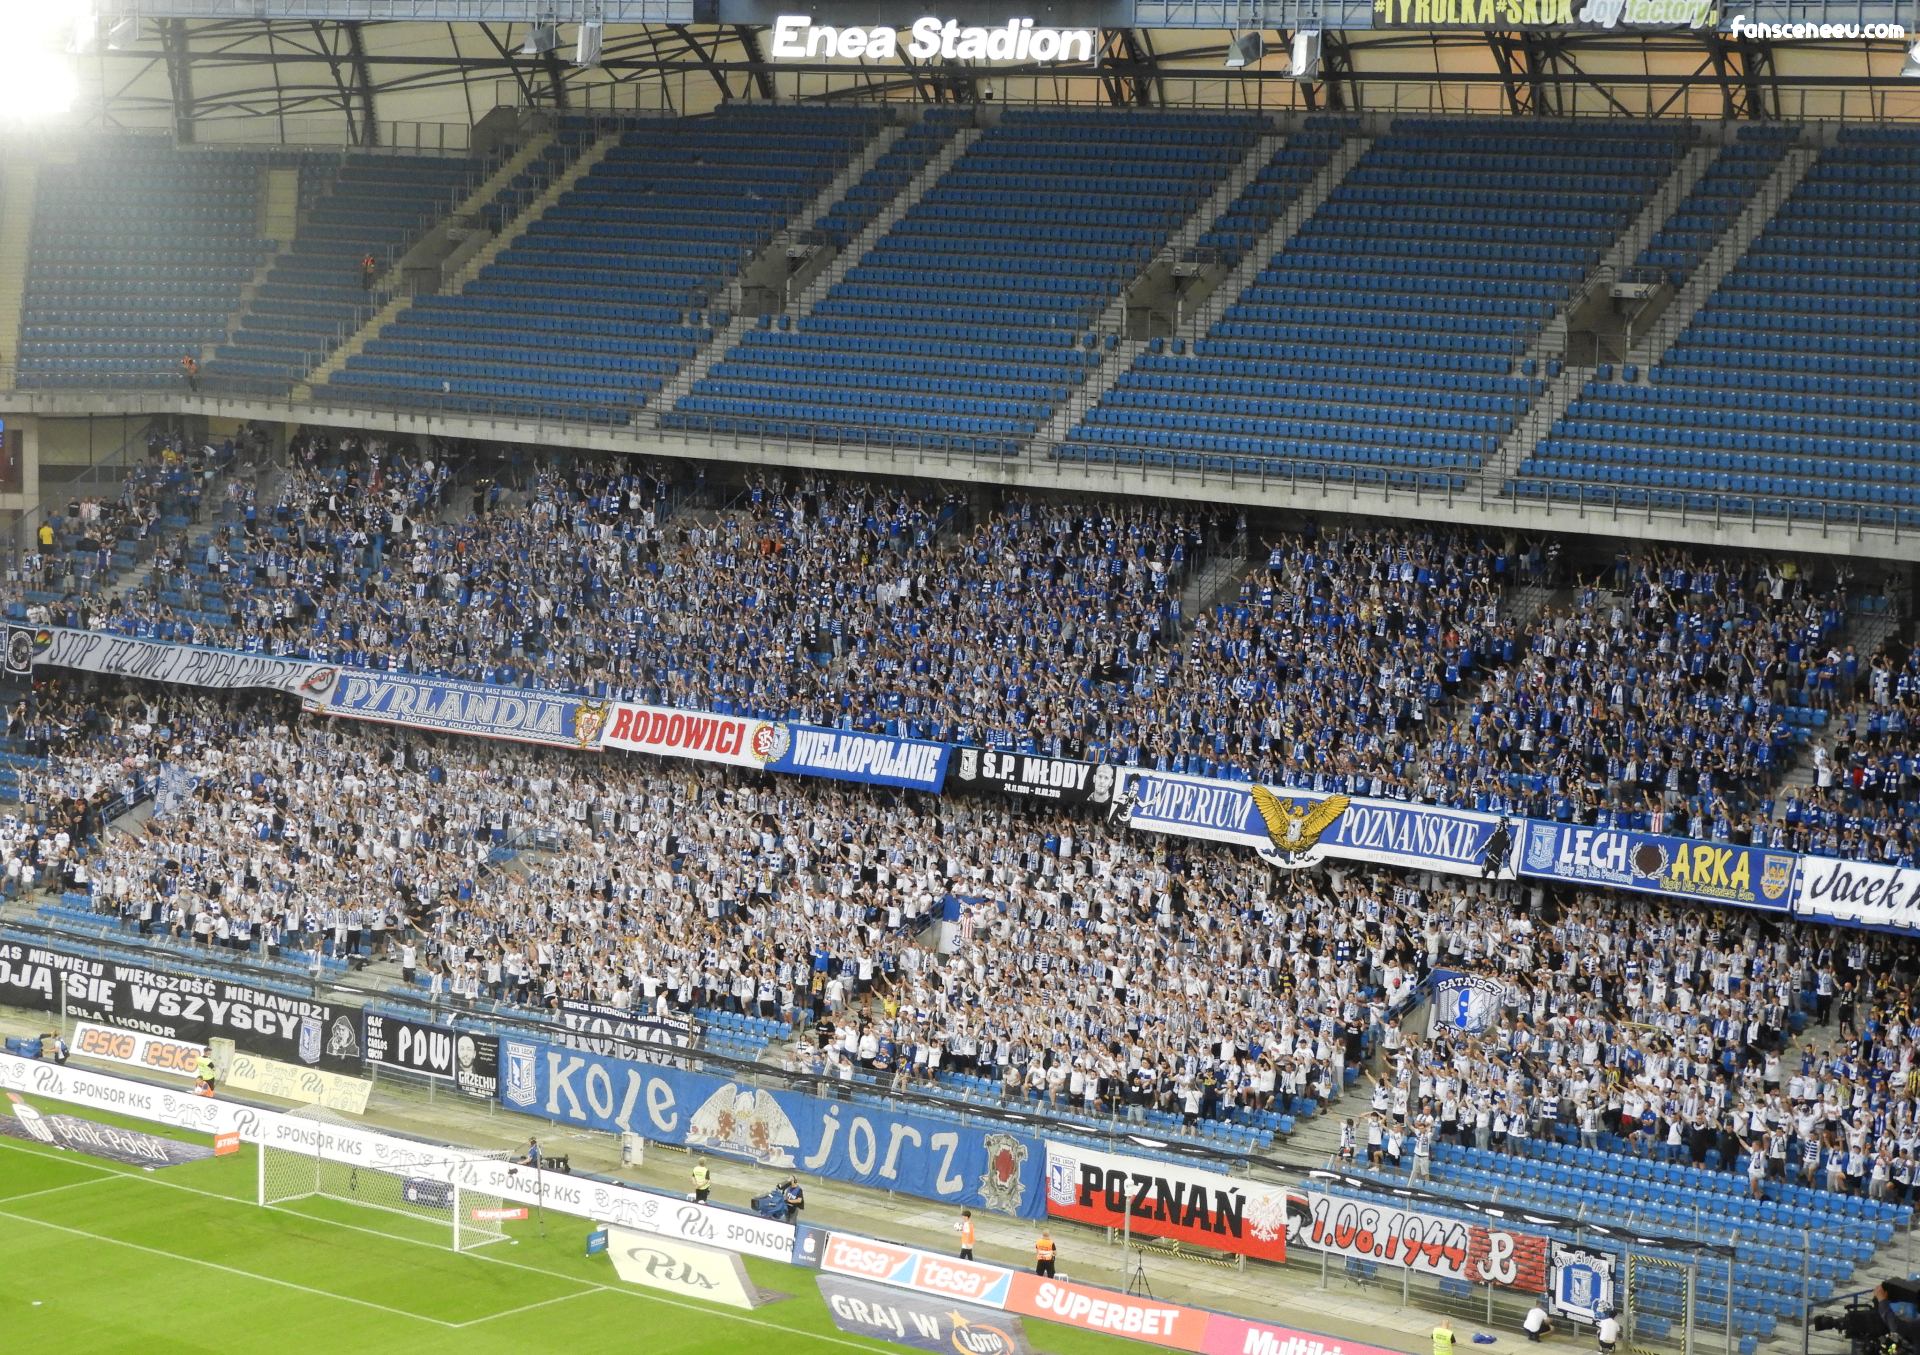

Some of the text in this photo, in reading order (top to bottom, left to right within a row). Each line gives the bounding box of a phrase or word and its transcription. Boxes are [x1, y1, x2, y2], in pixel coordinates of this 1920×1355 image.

[772, 15, 1092, 62] Enea Stadion
[49, 630, 102, 667] STOP
[176, 650, 312, 690] PROPAGANDZIE
[388, 674, 410, 684] NASZEJ
[485, 687, 501, 696] NASZ
[501, 689, 521, 697] WIELKI
[521, 691, 536, 699] LECH
[342, 678, 565, 735] PYRLANDIA
[400, 714, 491, 733] KRÓLESTWO KOLEJORZA
[609, 707, 746, 756] RODOWICI
[792, 729, 943, 783] WIELKOPOLANIE
[1022, 757, 1091, 790] MŁODY
[1140, 779, 1480, 863] IMPERIUM POZNAŃSKIE
[1560, 827, 1628, 872] LECH
[1671, 843, 1750, 890] ARKA
[1810, 862, 1904, 909] Jacek
[28, 948, 104, 977] NIEWIELU
[115, 966, 217, 997] WIĘKSZOŚĆ
[225, 985, 330, 1021] NIENAWIDZI
[1437, 976, 1503, 997] RATAJSCY
[66, 972, 117, 1012] SIĘ
[131, 984, 300, 1040] WSZYSCY
[66, 1004, 176, 1038] SIŁA I HONOR
[367, 1015, 383, 1028] OLAF
[563, 1000, 589, 1012] SERCE
[590, 1006, 631, 1019] STADIONU
[83, 1028, 136, 1060] eska
[367, 1025, 383, 1039] LOLA
[367, 1036, 388, 1051] CARLOS
[398, 1025, 451, 1071] PDW
[146, 1040, 200, 1072] eska
[232, 1057, 259, 1080] Pils
[33, 1065, 152, 1110] Pils SPONSOR KKS
[300, 1071, 328, 1096] Pils
[458, 1070, 497, 1090] GRZECHU
[51, 1116, 170, 1162] Bank Polski
[216, 1137, 240, 1149] STIHL
[277, 1125, 334, 1150] SPONSOR
[337, 1137, 362, 1156] KKS
[489, 1171, 550, 1198] SPONSOR
[555, 1186, 581, 1204] KKS
[1080, 1162, 1247, 1239] POZNAŃ
[477, 1208, 522, 1219] SUPERBET
[676, 1205, 720, 1240] Pils
[727, 1224, 795, 1252] SPONSOR
[1311, 1198, 1468, 1272] 1.08.1944
[626, 1247, 721, 1290] Pils
[833, 1241, 888, 1275] tesa
[923, 1260, 981, 1295] tesa
[830, 1294, 941, 1341] GRAJ W
[1034, 1282, 1179, 1336] SUPERBET
[959, 1328, 1003, 1353] LOTTO
